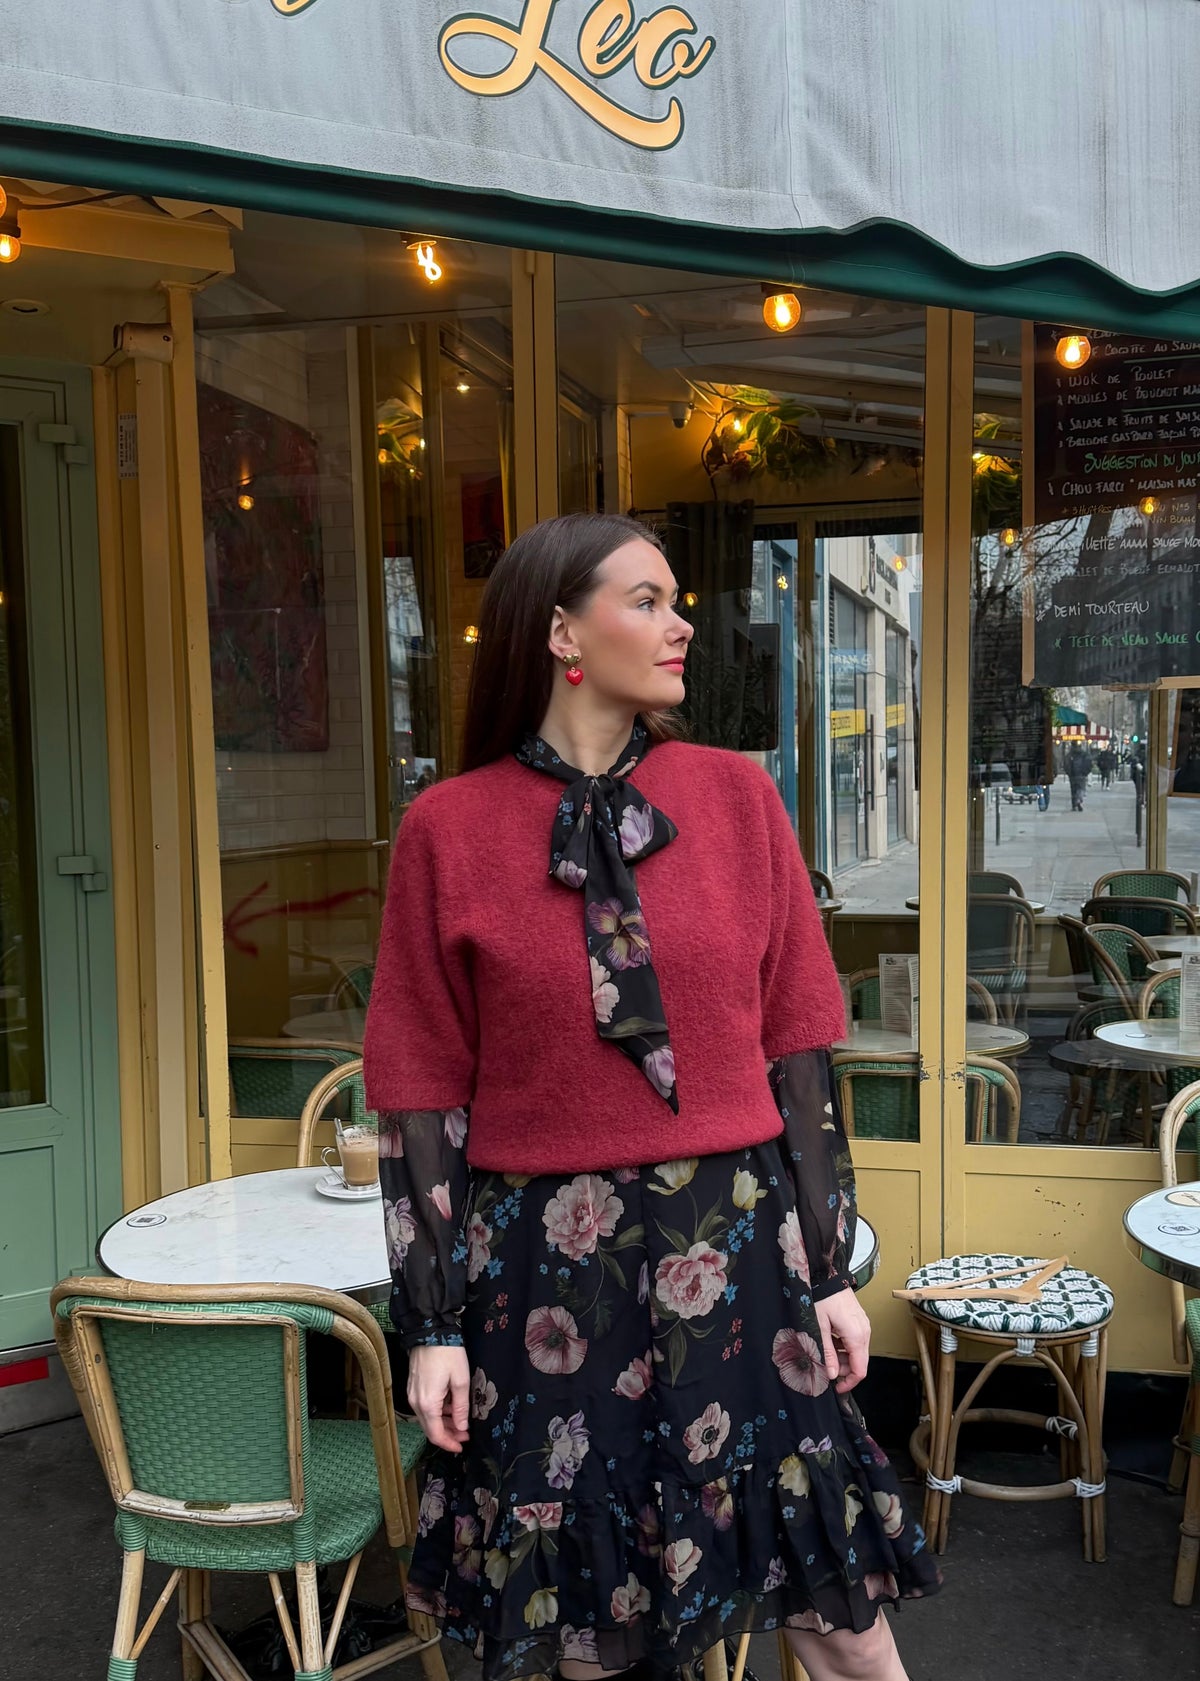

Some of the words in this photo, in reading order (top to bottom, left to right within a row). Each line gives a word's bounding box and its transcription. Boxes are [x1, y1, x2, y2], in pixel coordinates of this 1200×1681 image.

[1153, 343, 1169, 353] AU
[1068, 371, 1100, 388] WOK
[1107, 374, 1121, 384] DE
[1131, 365, 1175, 382] POULET
[1067, 391, 1108, 405] MOULES
[1116, 389, 1129, 401] DE
[1123, 413, 1154, 426] FRUITS
[1084, 452, 1158, 474] SUGGESTION
[1163, 453, 1176, 467] DU
[1062, 481, 1093, 496] CHOU
[1152, 537, 1182, 549] SAUCE
[1054, 602, 1081, 618] DEMI
[1085, 600, 1150, 615] TOURTEAU
[1102, 634, 1115, 647] DE
[1121, 630, 1149, 647] VEAU
[1155, 631, 1189, 645] SAUCE
